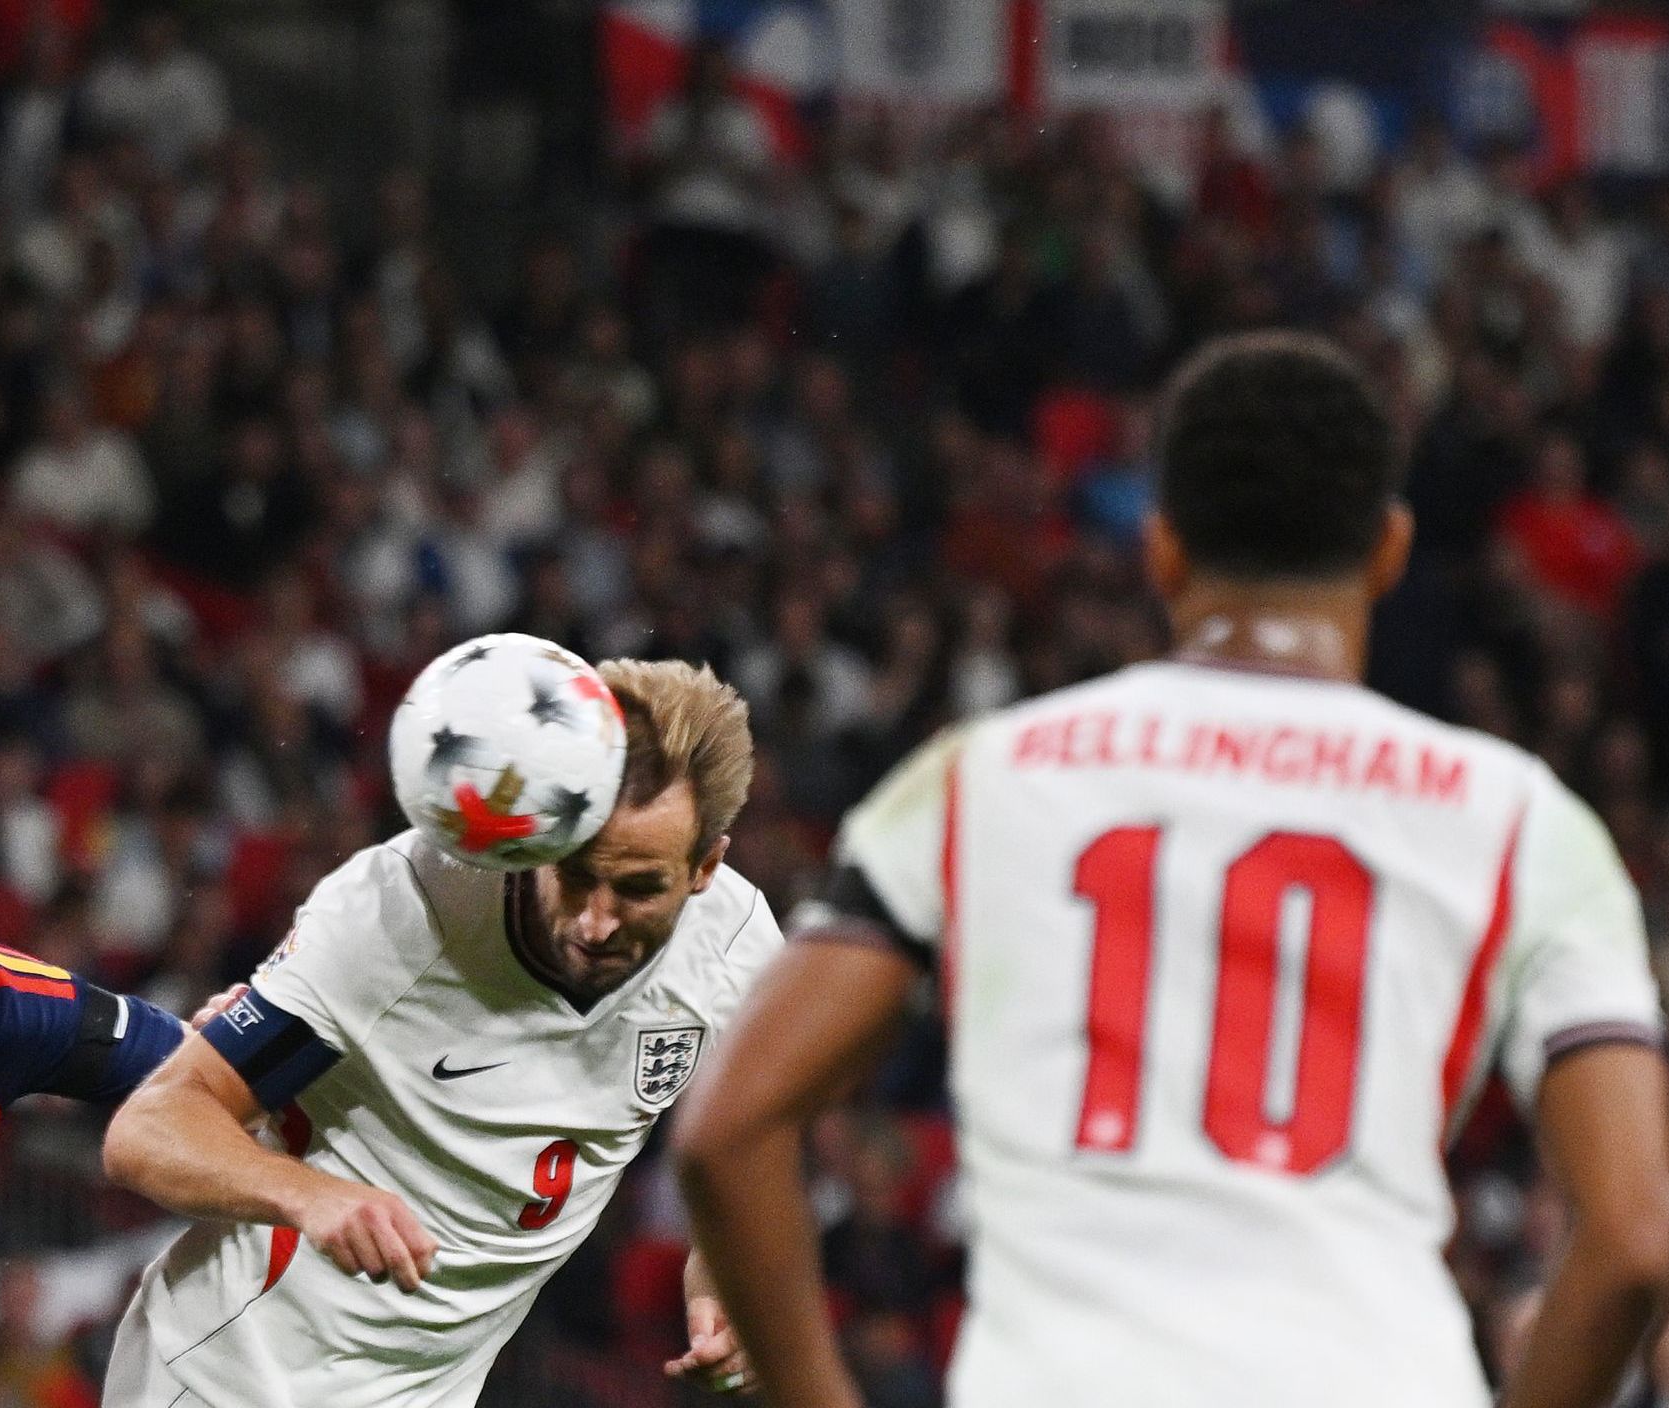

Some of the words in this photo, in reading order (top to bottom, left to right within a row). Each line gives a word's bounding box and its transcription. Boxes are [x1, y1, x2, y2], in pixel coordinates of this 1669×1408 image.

[1011, 709, 1470, 806] BELLINGHAM
[1070, 822, 1376, 1178] 10
[517, 1137, 581, 1231] 9
